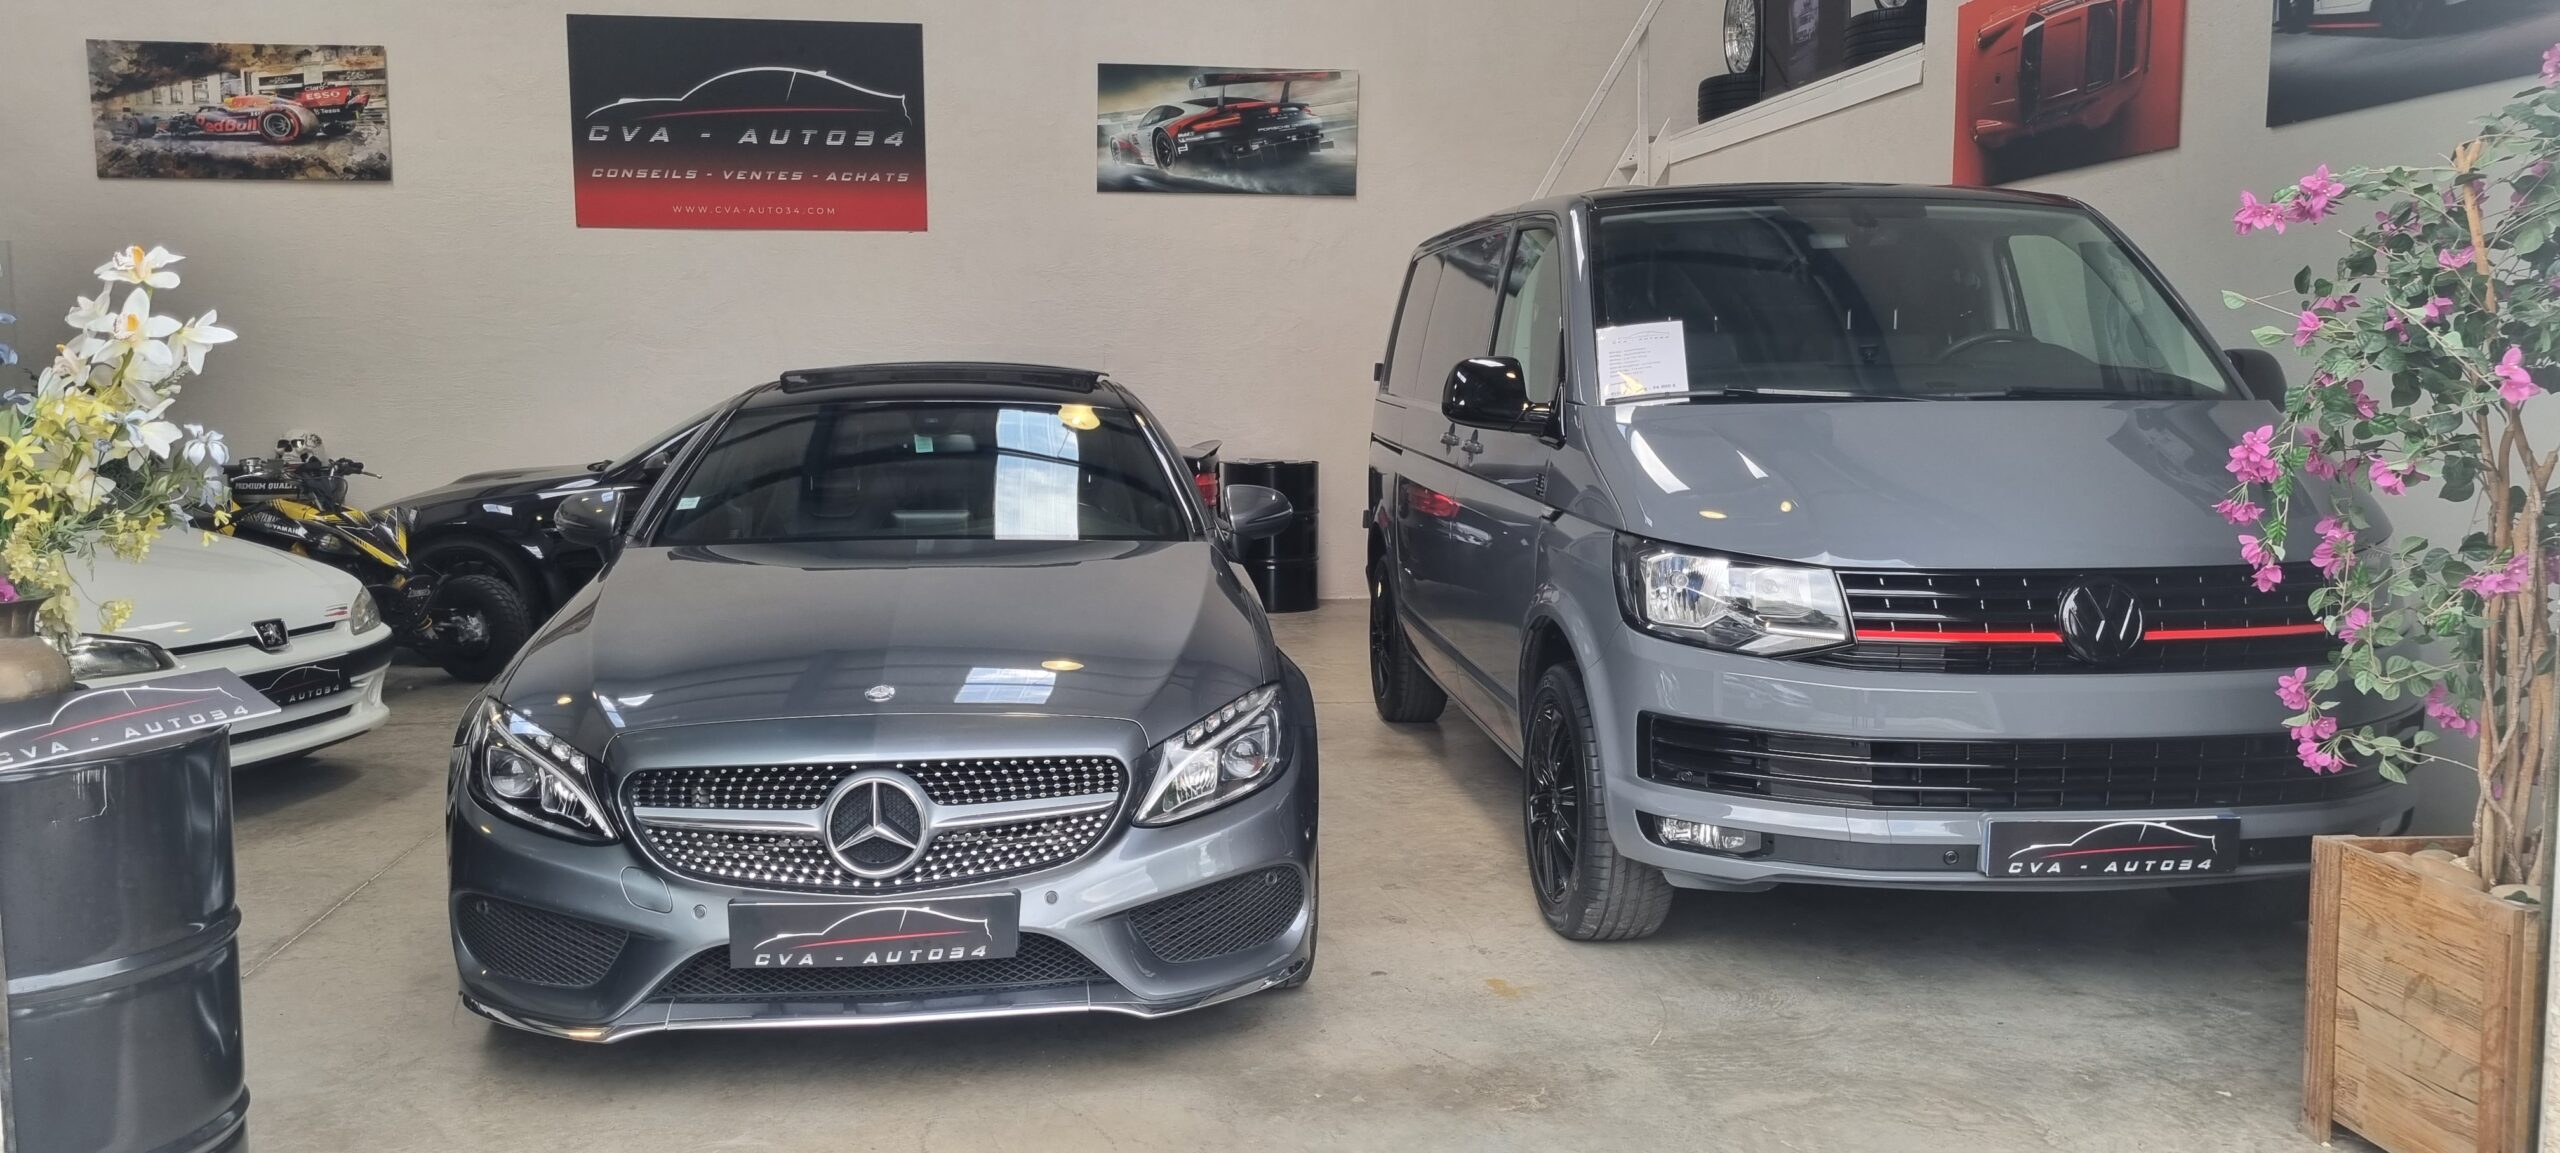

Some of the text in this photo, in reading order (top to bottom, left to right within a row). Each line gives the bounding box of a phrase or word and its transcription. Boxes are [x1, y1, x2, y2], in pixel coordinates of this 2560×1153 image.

[305, 90, 340, 101] ESSO
[588, 125, 670, 143] CVA
[738, 128, 904, 147] AUTO34
[591, 168, 698, 179] CONSEILS
[722, 170, 804, 181] VENTES
[826, 172, 910, 182] ACHATS
[672, 205, 836, 215] WWW.CVA-AUTO34.COM
[0, 741, 70, 764] CVA
[124, 705, 249, 740] AUTO34
[2008, 862, 2061, 873] CVA
[2104, 858, 2212, 873] AUTO34
[754, 953, 814, 966] CVA
[862, 945, 987, 965] AUTO34
